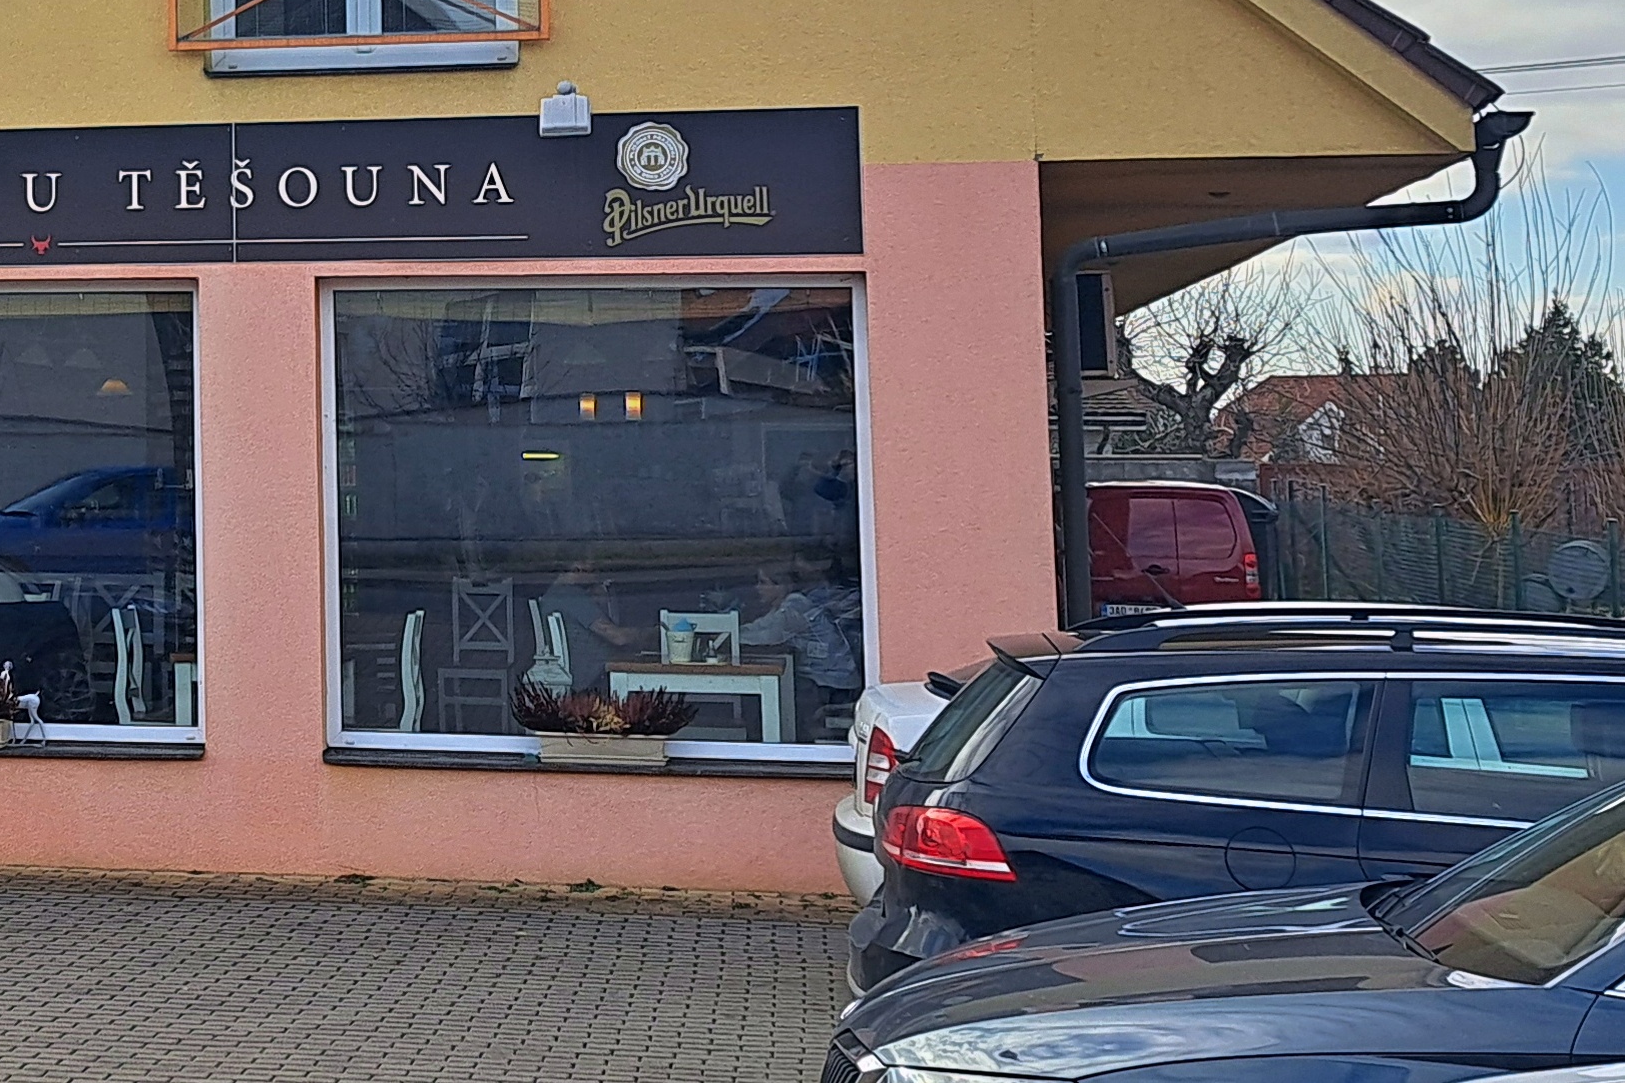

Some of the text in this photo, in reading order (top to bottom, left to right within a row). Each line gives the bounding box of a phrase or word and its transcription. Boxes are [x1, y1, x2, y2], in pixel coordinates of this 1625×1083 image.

[22, 172, 63, 212] U
[118, 159, 515, 210] TĚŠOUNA
[603, 185, 769, 247] Pilsner Urquell
